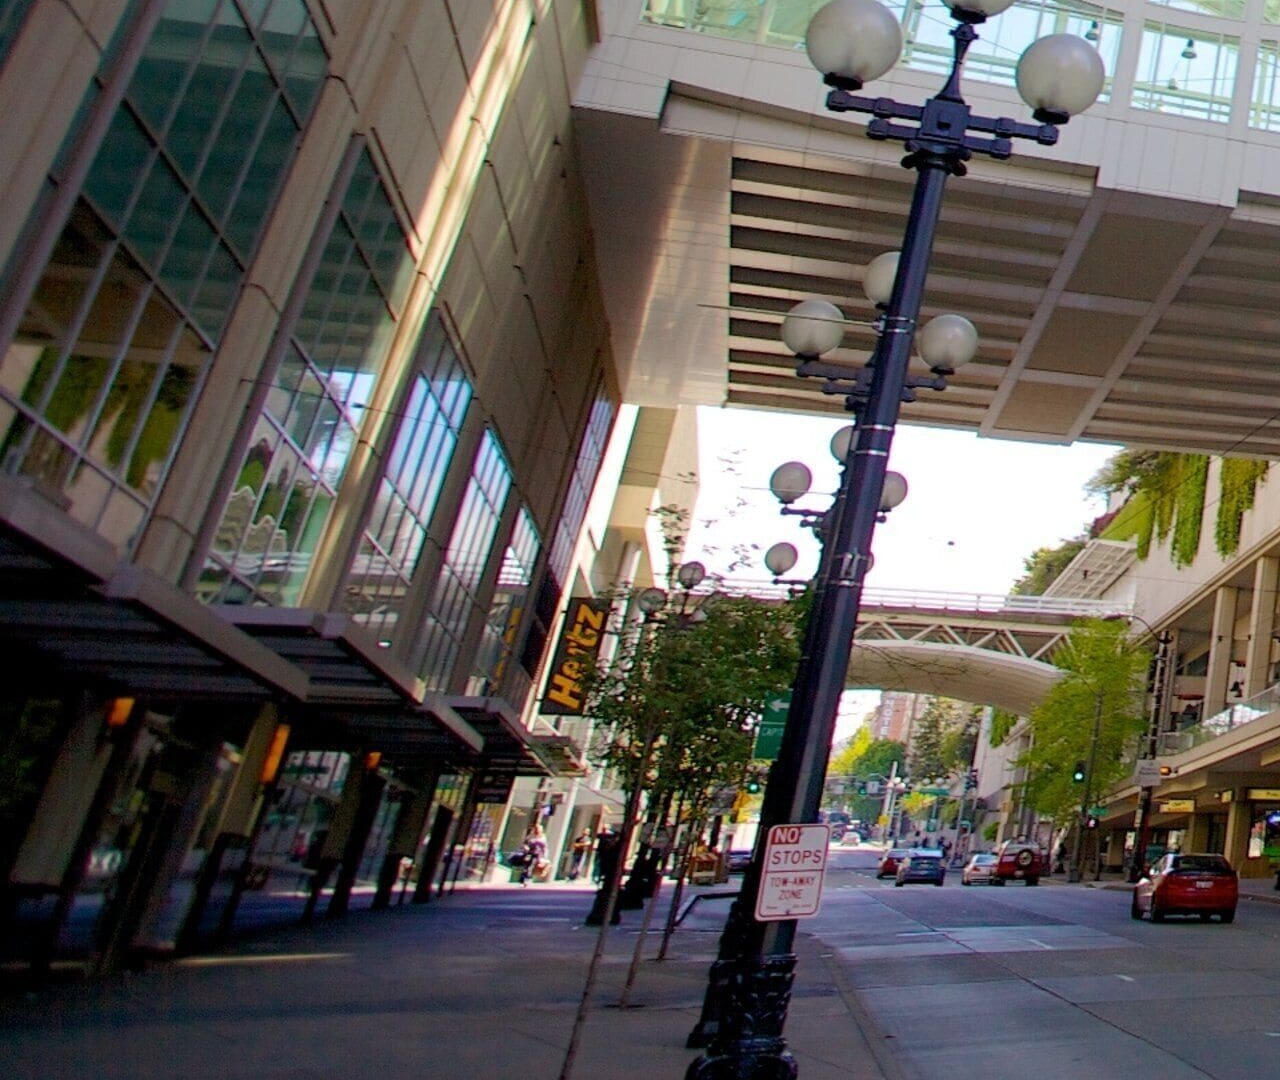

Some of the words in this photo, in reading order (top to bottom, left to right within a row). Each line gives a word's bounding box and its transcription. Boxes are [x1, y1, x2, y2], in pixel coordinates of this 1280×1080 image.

[548, 603, 604, 709] Hertz
[773, 827, 801, 844] NO
[771, 850, 821, 865] STOPS
[771, 877, 815, 888] TOW-AWAY
[779, 889, 803, 901] ZONE
